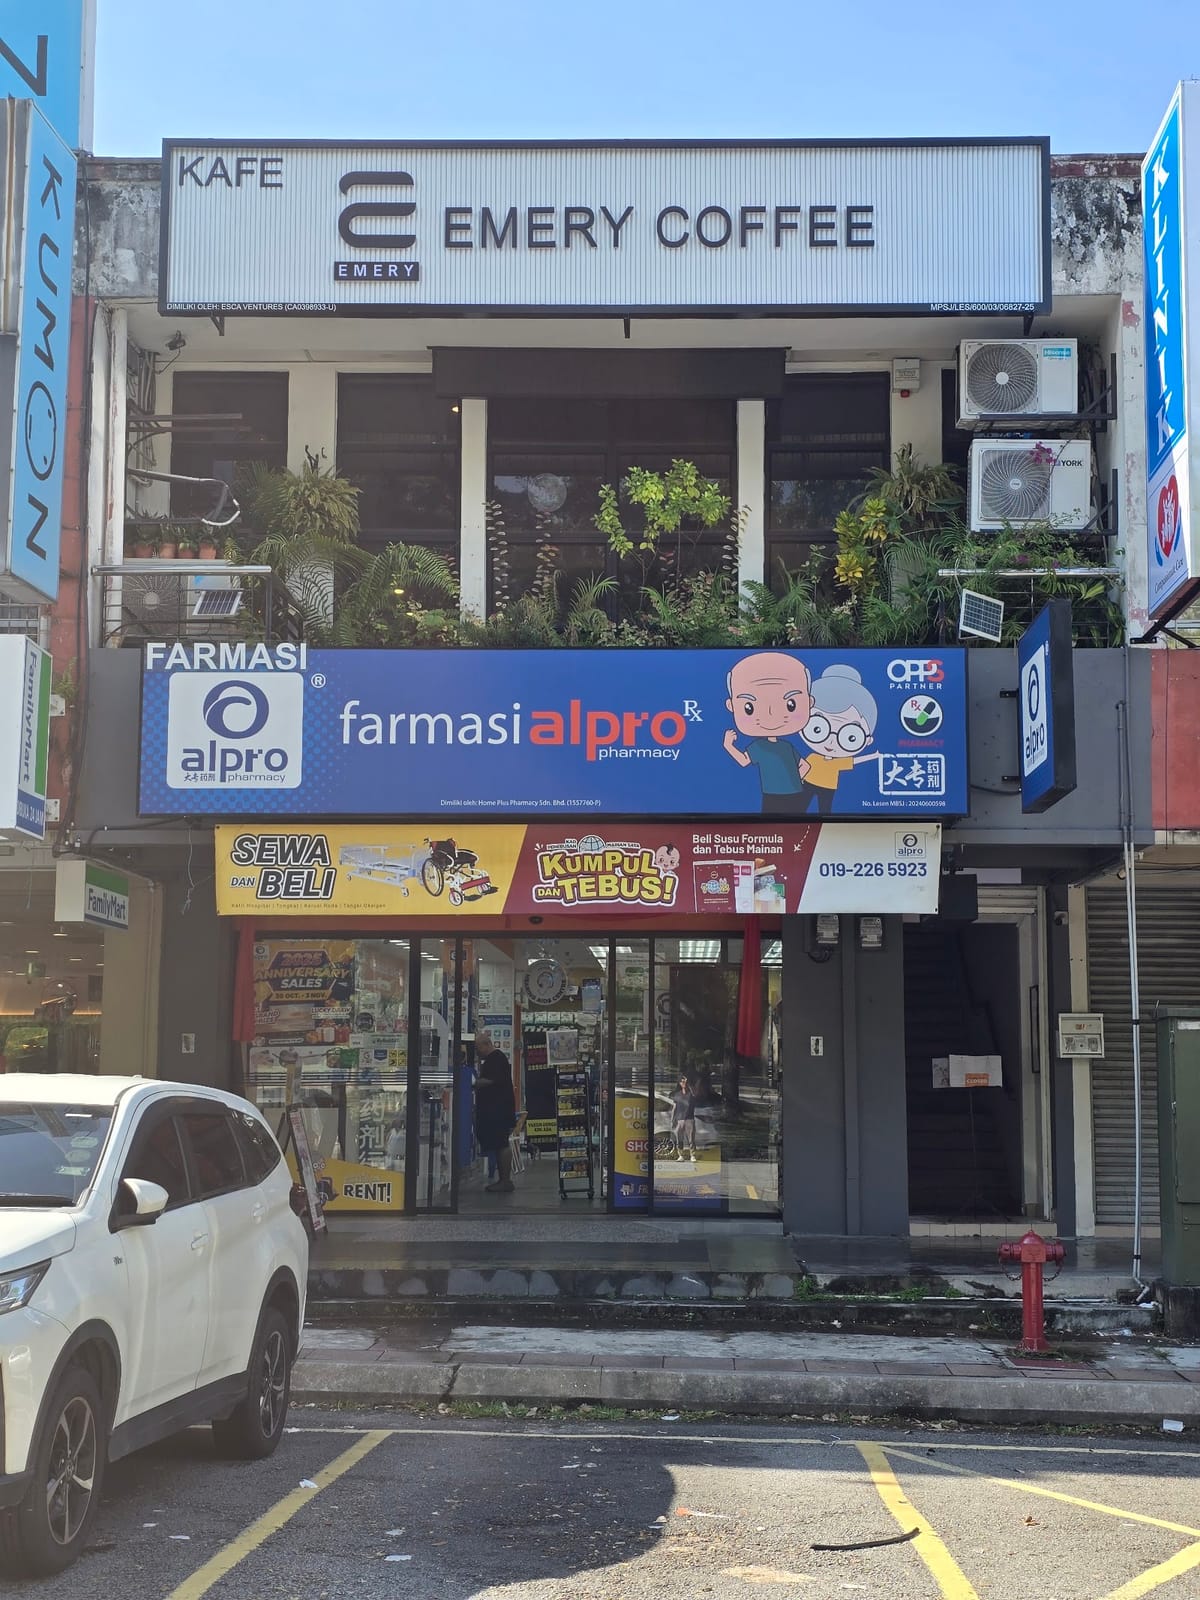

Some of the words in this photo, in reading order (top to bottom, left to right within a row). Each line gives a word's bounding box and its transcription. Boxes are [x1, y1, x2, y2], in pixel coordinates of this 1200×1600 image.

[179, 156, 283, 187] KAFE
[445, 206, 635, 248] EMERY
[656, 205, 875, 248] COFFEE
[338, 264, 415, 277] EMERY
[1151, 135, 1175, 456] KLINIK
[167, 303, 196, 311] DIMILIKI
[198, 303, 220, 311] OLEH:
[221, 303, 242, 311] ESCA
[243, 303, 283, 311] VENTURES
[25, 153, 63, 560] KUMON
[1061, 459, 1082, 467] YORK
[146, 642, 308, 670] FARMASI
[23, 650, 38, 783] FamilyMart
[339, 700, 521, 745] farmasi
[529, 699, 687, 761] alpro
[1026, 722, 1045, 765] alpro
[181, 740, 289, 783] alpro
[599, 746, 680, 761] pharmacy
[228, 773, 286, 783] pharmacy
[440, 799, 462, 807] Dimiliki
[463, 799, 478, 807] oleh:
[478, 799, 497, 807] Home
[497, 799, 509, 807] Plus
[510, 799, 538, 808] Pharmacy
[539, 799, 553, 807] Sdn.
[553, 799, 565, 807] Bhd.
[692, 834, 712, 844] Beli
[714, 834, 739, 844] Susu
[741, 834, 783, 844] Formula
[232, 834, 331, 867] SEWA
[692, 844, 712, 854] dan
[714, 844, 745, 854] Tebus
[746, 844, 783, 854] Mainan
[898, 847, 923, 856] alpro
[541, 850, 658, 878] KUMPUL
[819, 862, 884, 877] 019-226
[887, 862, 927, 877] 5923
[231, 877, 255, 887] DAN
[257, 868, 336, 899] BELI
[557, 874, 675, 901] TEBUS!
[537, 887, 561, 897] DAN
[88, 887, 126, 921] FamilyMart
[255, 967, 350, 980] ANNIVERSARY
[280, 979, 322, 989] SALES
[621, 1106, 649, 1120] Clic
[343, 1182, 392, 1204] RENT!
